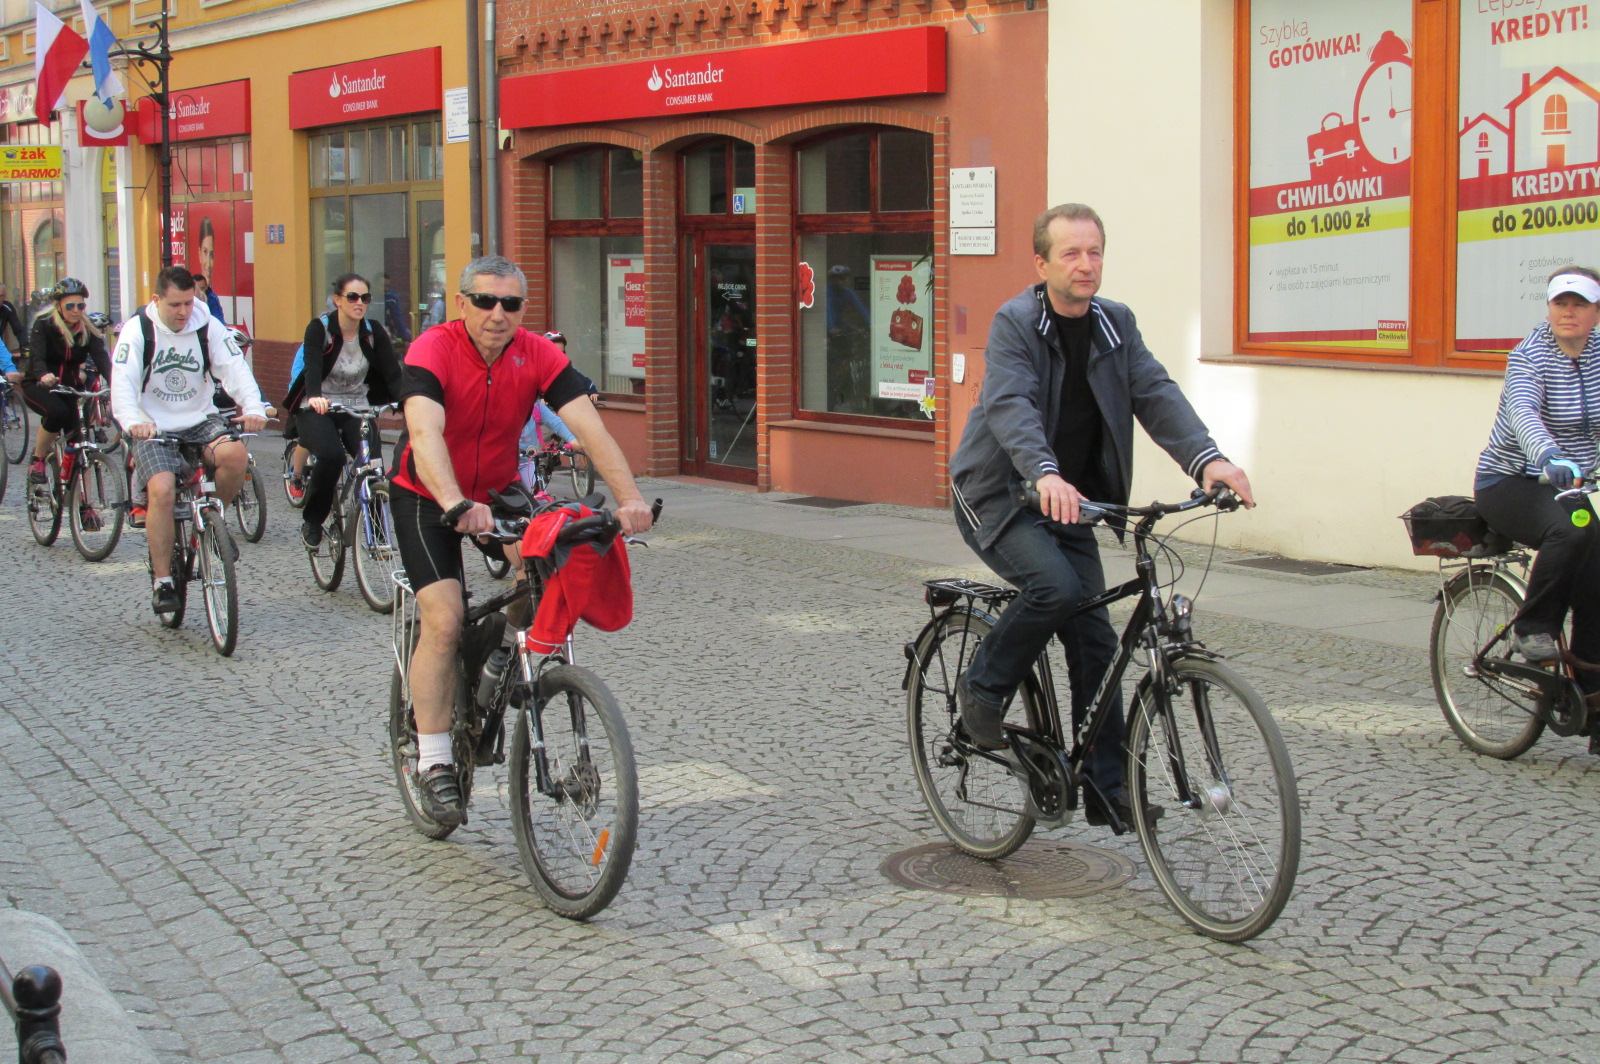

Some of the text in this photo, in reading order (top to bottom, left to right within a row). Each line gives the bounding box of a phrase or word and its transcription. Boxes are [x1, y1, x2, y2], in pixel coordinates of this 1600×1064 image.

[1259, 17, 1309, 48] Szybka
[1490, 4, 1589, 46] KREDYT!
[1269, 32, 1361, 69] GOTÓWKA!
[341, 68, 386, 96] Santander
[664, 61, 724, 89] Santander
[178, 96, 210, 118] Santander
[342, 99, 379, 113] CONSUMER BANK
[665, 92, 713, 106] CONSUMER BANK
[20, 147, 46, 160] żak
[11, 168, 61, 178] DARMO!
[1511, 167, 1600, 198] KREDYTY
[1276, 175, 1383, 210] CHWILÓWKI
[1286, 206, 1371, 237] do 1.000 zł
[1492, 201, 1598, 234] do 200.000
[1309, 263, 1318, 274] 15
[1319, 262, 1339, 273] minut
[1528, 256, 1575, 270] gotówkowe
[117, 344, 128, 363] 6
[152, 387, 198, 402] OUTFITTERS
